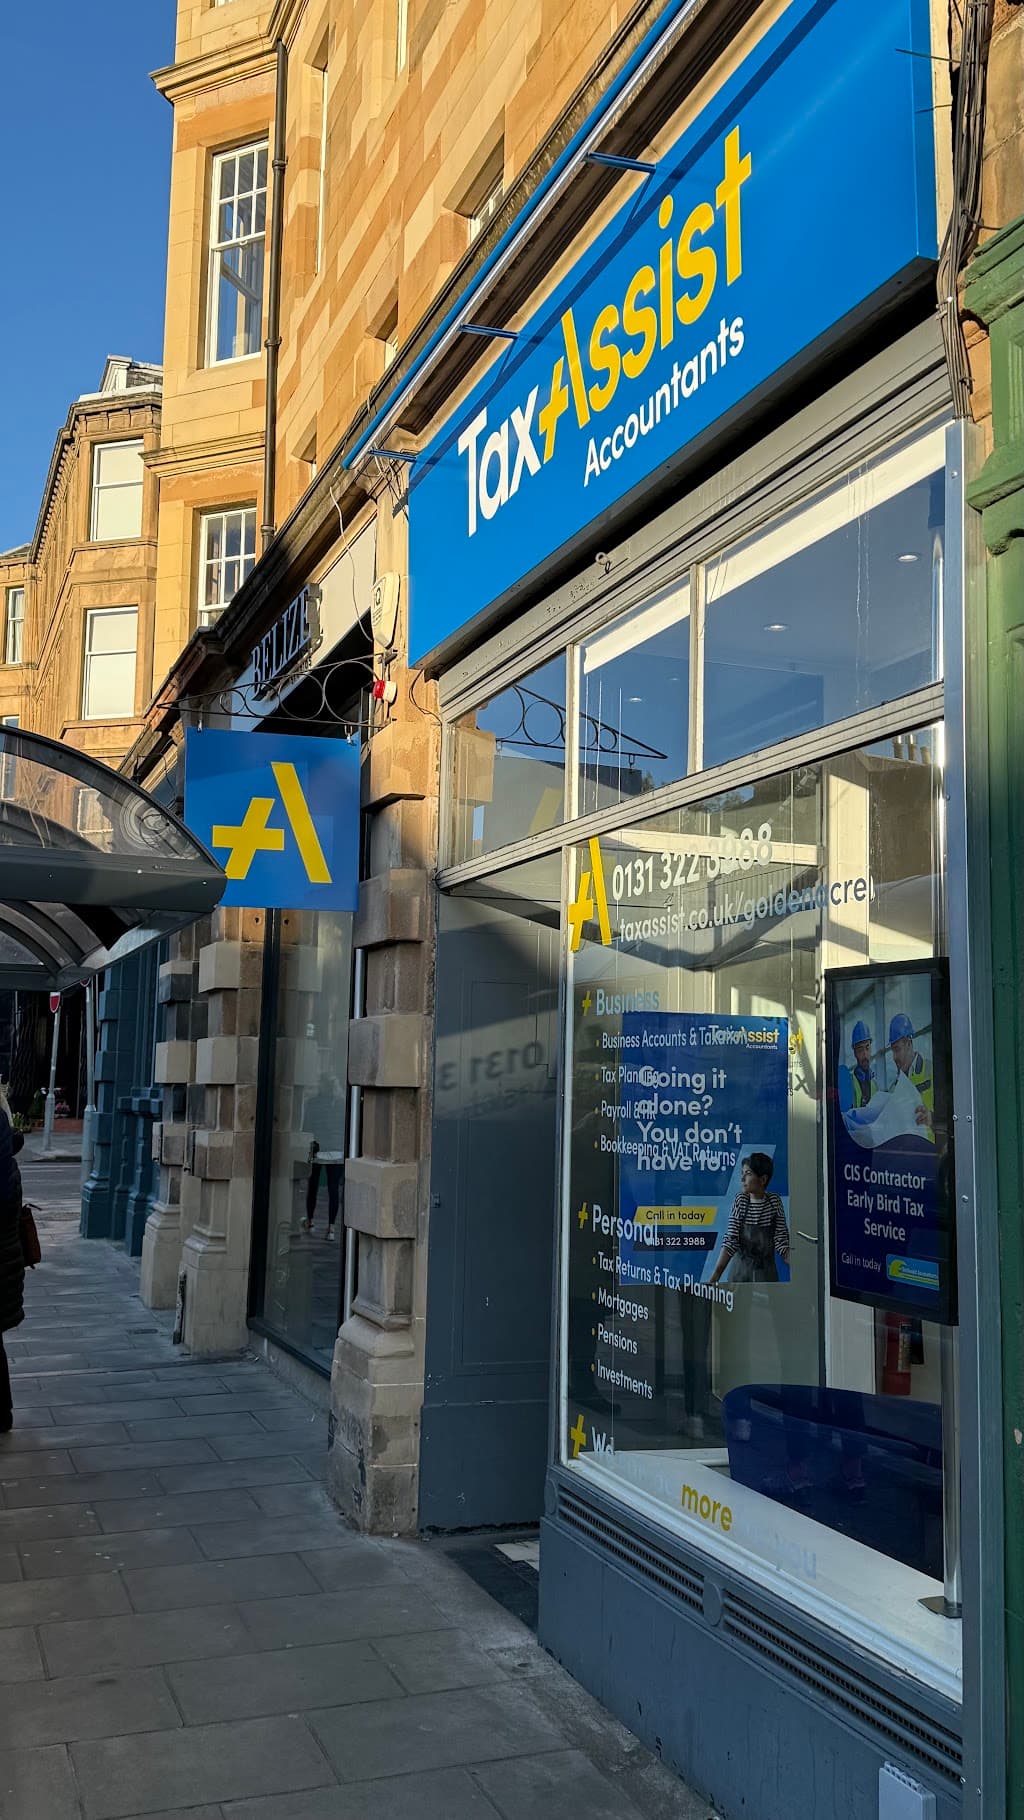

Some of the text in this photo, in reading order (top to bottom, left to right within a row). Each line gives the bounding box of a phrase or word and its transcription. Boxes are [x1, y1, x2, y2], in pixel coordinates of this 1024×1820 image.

[458, 125, 752, 538] TaxAssist
[584, 316, 745, 487] Accountants
[251, 583, 311, 696] BELIZE
[612, 856, 654, 901] 0131
[659, 845, 700, 890] 322
[596, 988, 659, 1016] Business
[602, 1032, 640, 1049] Business
[642, 1029, 687, 1047] Accounts
[689, 1027, 697, 1046] &
[601, 1066, 616, 1082] Tax
[638, 1065, 727, 1095] Going it
[601, 1100, 631, 1123] Payroll
[633, 1102, 642, 1120] &
[637, 1121, 679, 1144] You
[600, 1134, 736, 1167] Bookkeeping & VAT Returns
[637, 1148, 693, 1171] have
[844, 1164, 926, 1191] CIS Contractor
[646, 1210, 706, 1222] Call in today
[847, 1190, 925, 1218] Early Bird Tax
[592, 1203, 659, 1247] Personal
[864, 1218, 906, 1242] Service
[666, 1237, 681, 1246] 322
[683, 1237, 706, 1246] 3988
[841, 1252, 882, 1273] Call in today
[598, 1252, 735, 1313] Tax Returns & Tax Planning
[598, 1288, 649, 1322] Mortgages
[597, 1323, 638, 1355] Pensions
[597, 1359, 653, 1400] Investments
[681, 1483, 733, 1532] more
